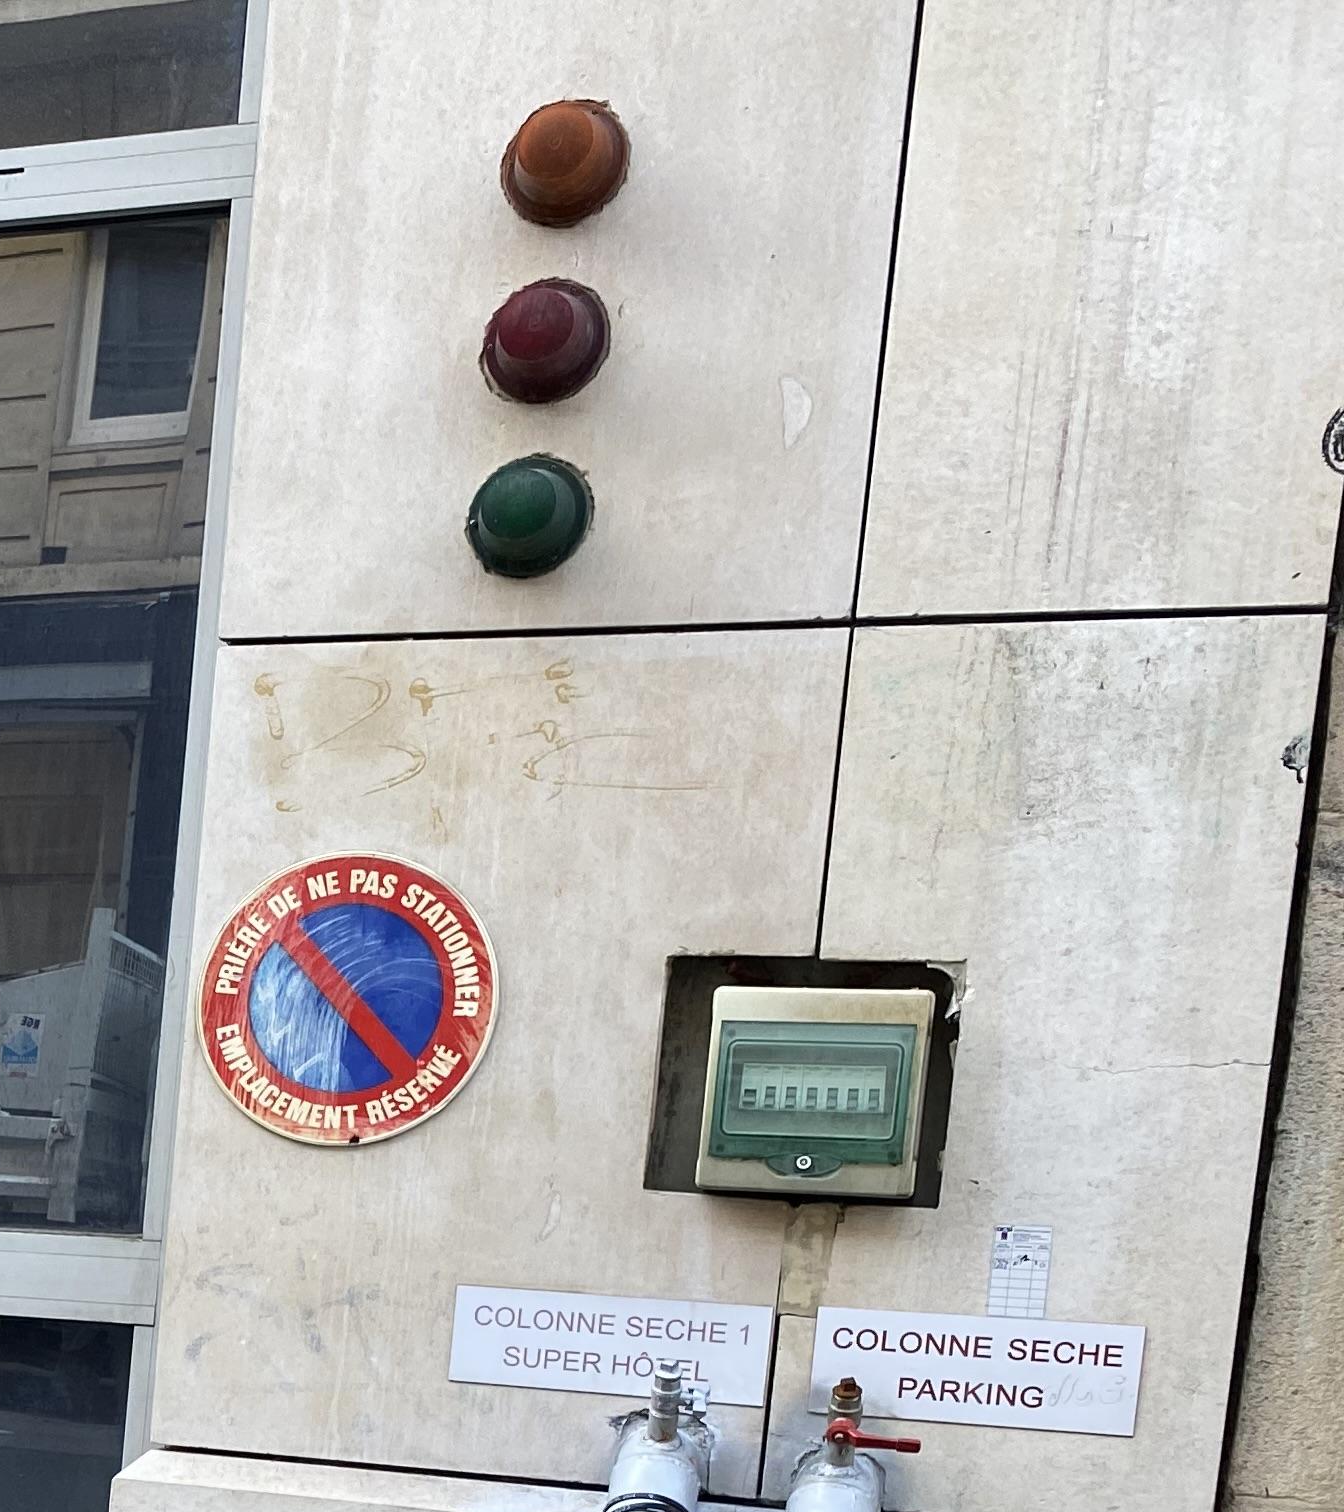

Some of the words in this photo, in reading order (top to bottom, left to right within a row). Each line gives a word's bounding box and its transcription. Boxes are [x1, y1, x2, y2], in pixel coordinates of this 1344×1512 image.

[215, 914, 272, 995] PRIÈRE
[267, 886, 302, 919] DE
[306, 871, 340, 900] NE
[349, 868, 398, 899] PAS
[401, 883, 481, 1018] STATIONNER
[216, 1023, 358, 1129] EMPLACEMENT
[365, 1044, 462, 1125] RÉSERVÉ
[474, 1304, 616, 1336] COLONNE
[625, 1315, 728, 1344] SECHE
[739, 1324, 750, 1346] 1
[502, 1345, 601, 1374] SUPER
[832, 1327, 993, 1359] COLONNE
[1007, 1337, 1124, 1368] SECHE
[897, 1376, 1044, 1409] PARKING
